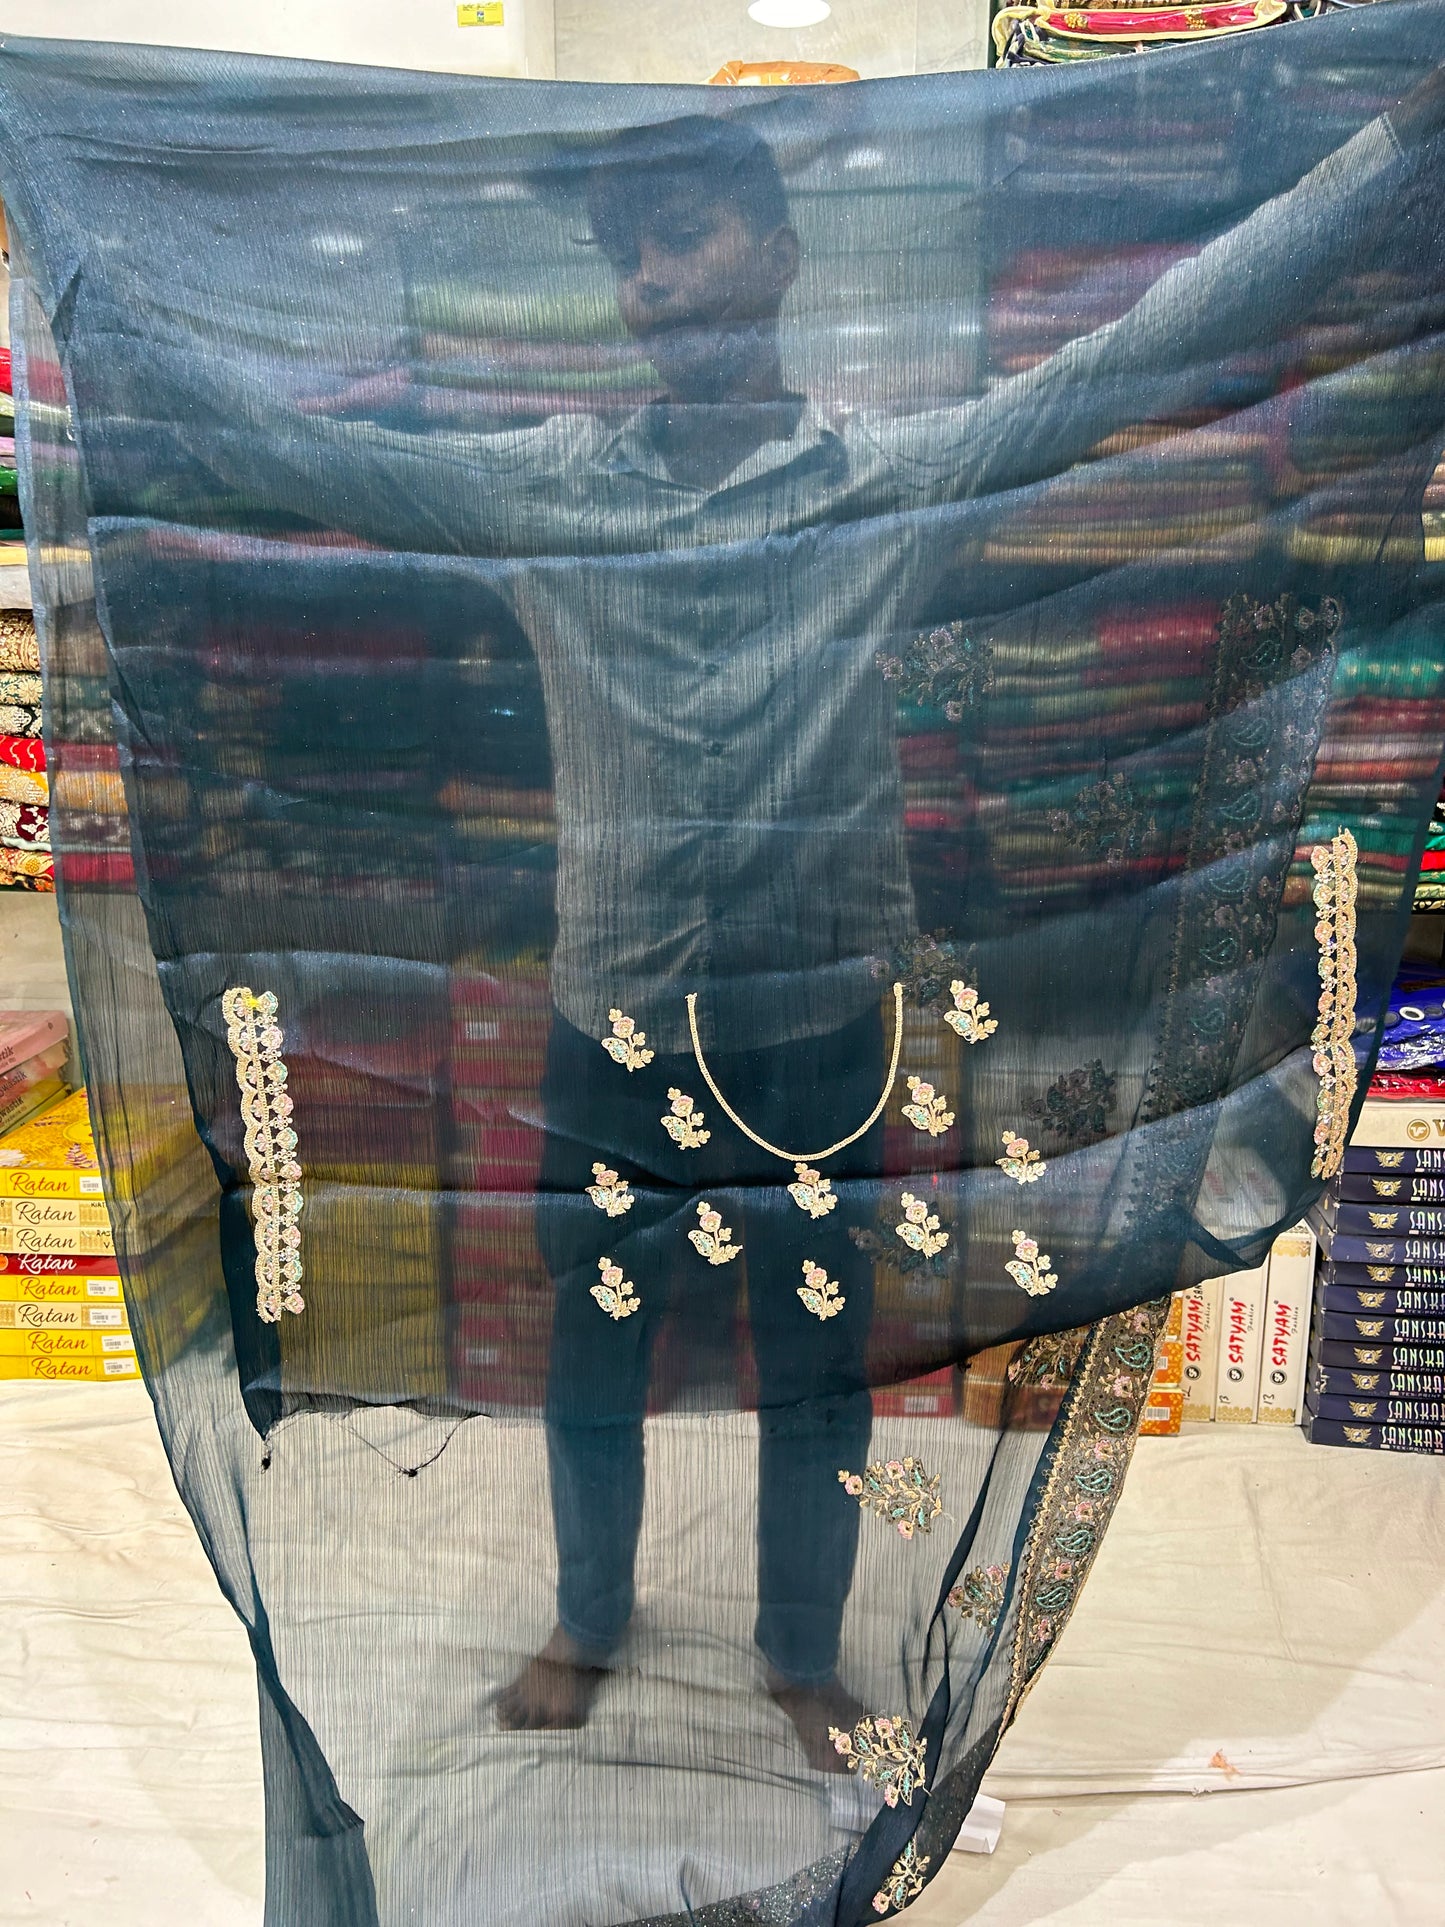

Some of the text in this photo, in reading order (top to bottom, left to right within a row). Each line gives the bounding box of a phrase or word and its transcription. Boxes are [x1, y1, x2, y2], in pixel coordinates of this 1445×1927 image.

[10, 1172, 71, 1195] Ratan
[16, 1201, 76, 1225] Ratan
[16, 1228, 77, 1252] Ratan
[18, 1253, 77, 1274] Ratan
[20, 1276, 80, 1300] Ratan
[18, 1304, 78, 1327] Ratan
[1185, 1299, 1204, 1361] SATYAM
[1228, 1301, 1247, 1363] SATYAM
[1271, 1303, 1292, 1366] SATYAM
[28, 1331, 88, 1354] Ratan
[31, 1357, 92, 1379] Ratan
[1381, 1426, 1443, 1448] SANSKAR
